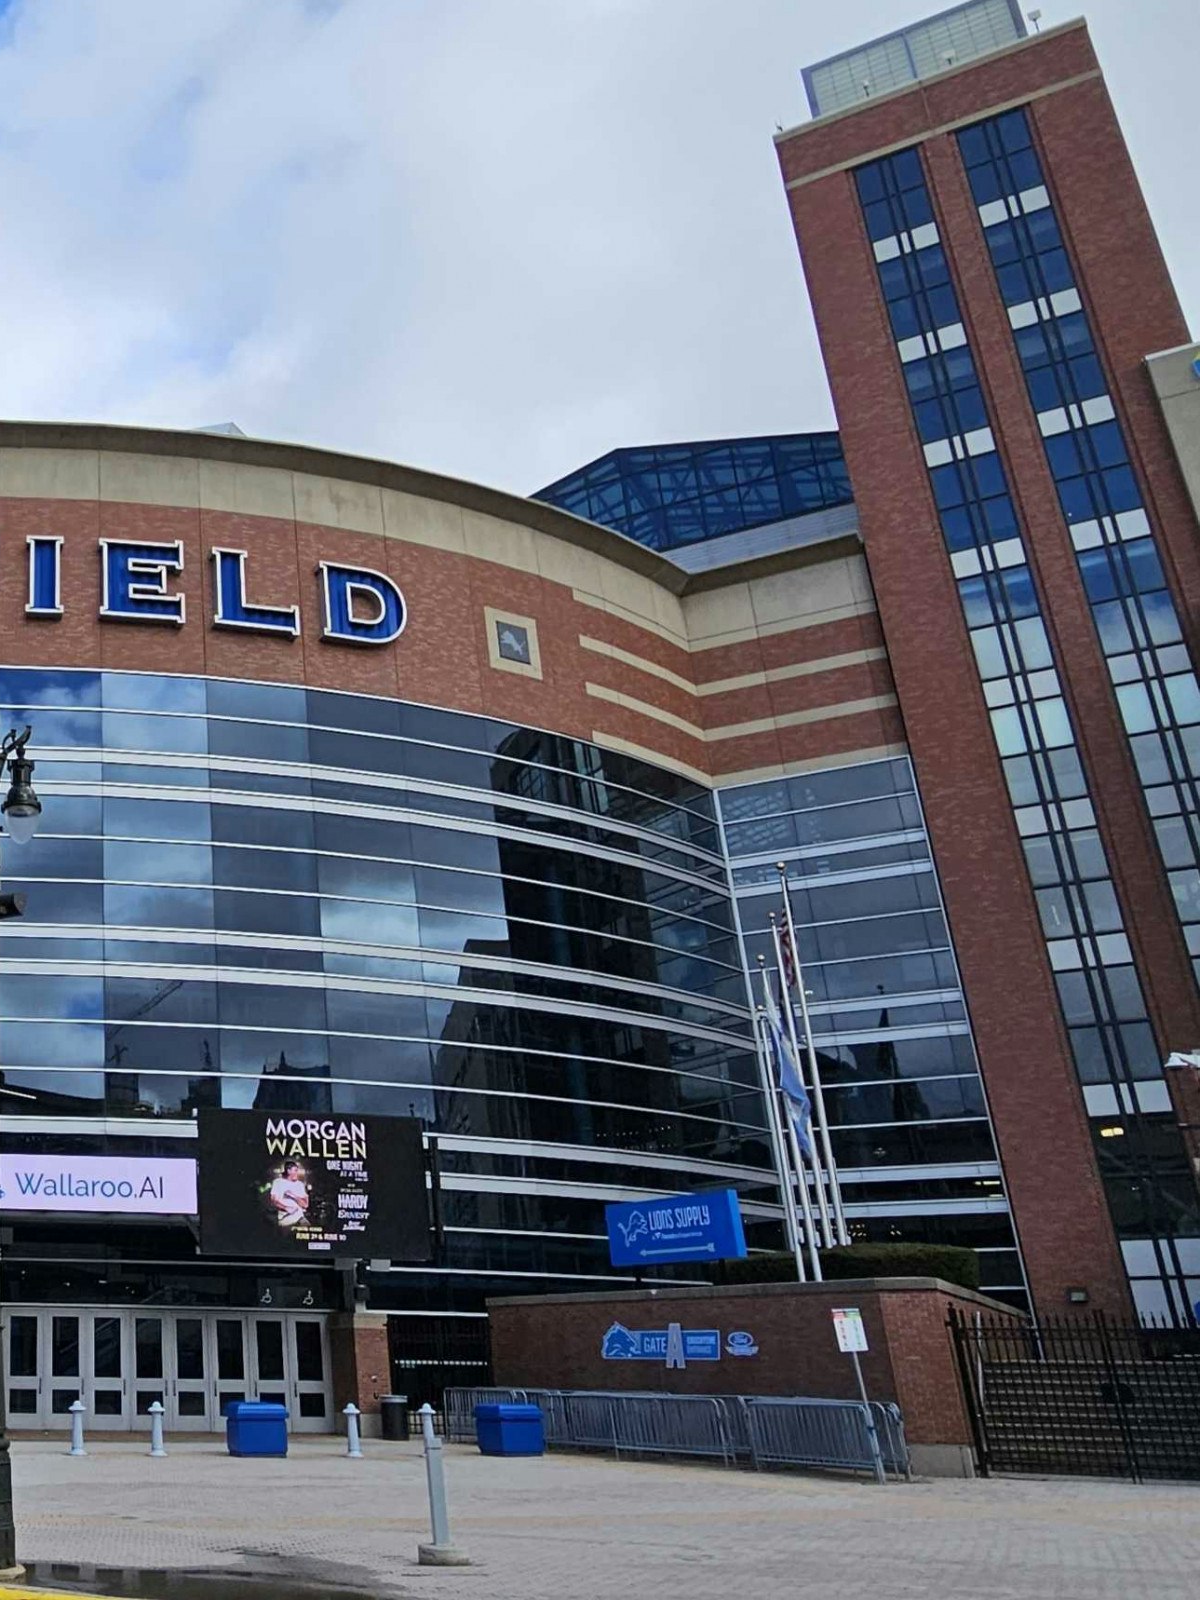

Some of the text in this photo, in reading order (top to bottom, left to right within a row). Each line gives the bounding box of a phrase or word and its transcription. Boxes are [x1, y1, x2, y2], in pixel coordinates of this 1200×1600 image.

[265, 1118, 366, 1141] MORGAN
[266, 1138, 367, 1159] WALLEN
[15, 1172, 164, 1200] Wallaroo.AI
[338, 1194, 368, 1209] HARDY
[648, 1205, 711, 1231] LIONS SUPPLY
[643, 1322, 686, 1369] GATE A
